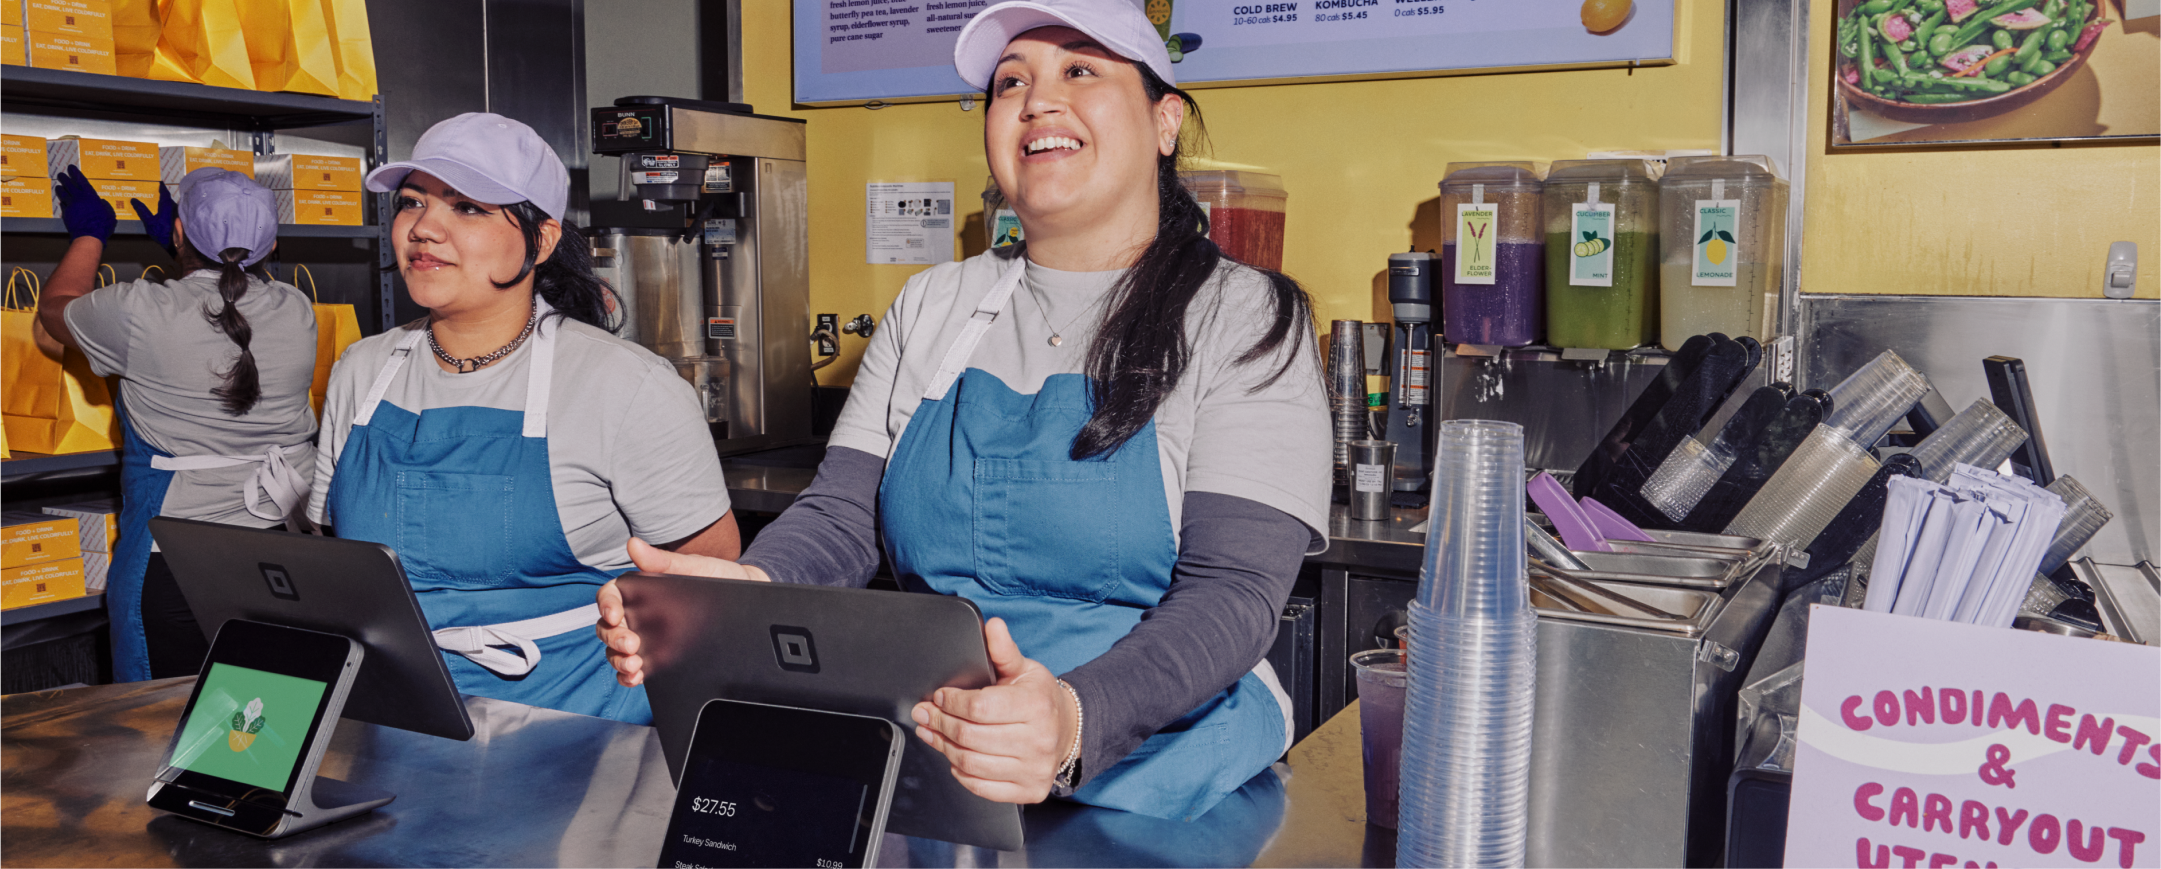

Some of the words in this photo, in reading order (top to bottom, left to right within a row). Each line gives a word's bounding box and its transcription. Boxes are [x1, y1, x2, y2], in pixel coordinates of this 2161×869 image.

[968, 0, 988, 8] juice,
[1233, 6, 1262, 15] COLD
[1266, 3, 1298, 12] BREW
[1315, 0, 1378, 10] KOMBUCHA
[74, 9, 106, 18] COLORFULLY
[830, 10, 859, 20] butterfly
[861, 10, 874, 18] pea
[890, 6, 919, 14] lavender
[926, 12, 962, 22] all-natural
[1315, 14, 1326, 22] 80
[1327, 13, 1340, 22] cals
[1342, 11, 1368, 20] $5.45
[1394, 8, 1400, 17] 0
[1402, 8, 1416, 16] cals
[1418, 6, 1444, 16] $5.95
[1234, 16, 1258, 25] 10-60
[1258, 16, 1271, 24] cals
[1272, 14, 1298, 23] $4.95
[830, 24, 850, 32] syrup,
[851, 20, 888, 29] elderflower
[889, 19, 910, 27] syrup,
[830, 36, 846, 44] pure
[78, 48, 109, 56] COLORFULLY
[40, 530, 74, 539] COLORFULLY
[45, 570, 79, 579] COLORFULLY
[1840, 686, 2161, 780] CONDIMENTS
[1978, 744, 2016, 788] &
[692, 796, 736, 817] $27.55
[1854, 782, 2146, 869] CARRYOUT
[683, 834, 704, 848] Turkey
[704, 837, 737, 851] Sandwich
[675, 861, 693, 869] Steak
[816, 858, 843, 869] $10.99
